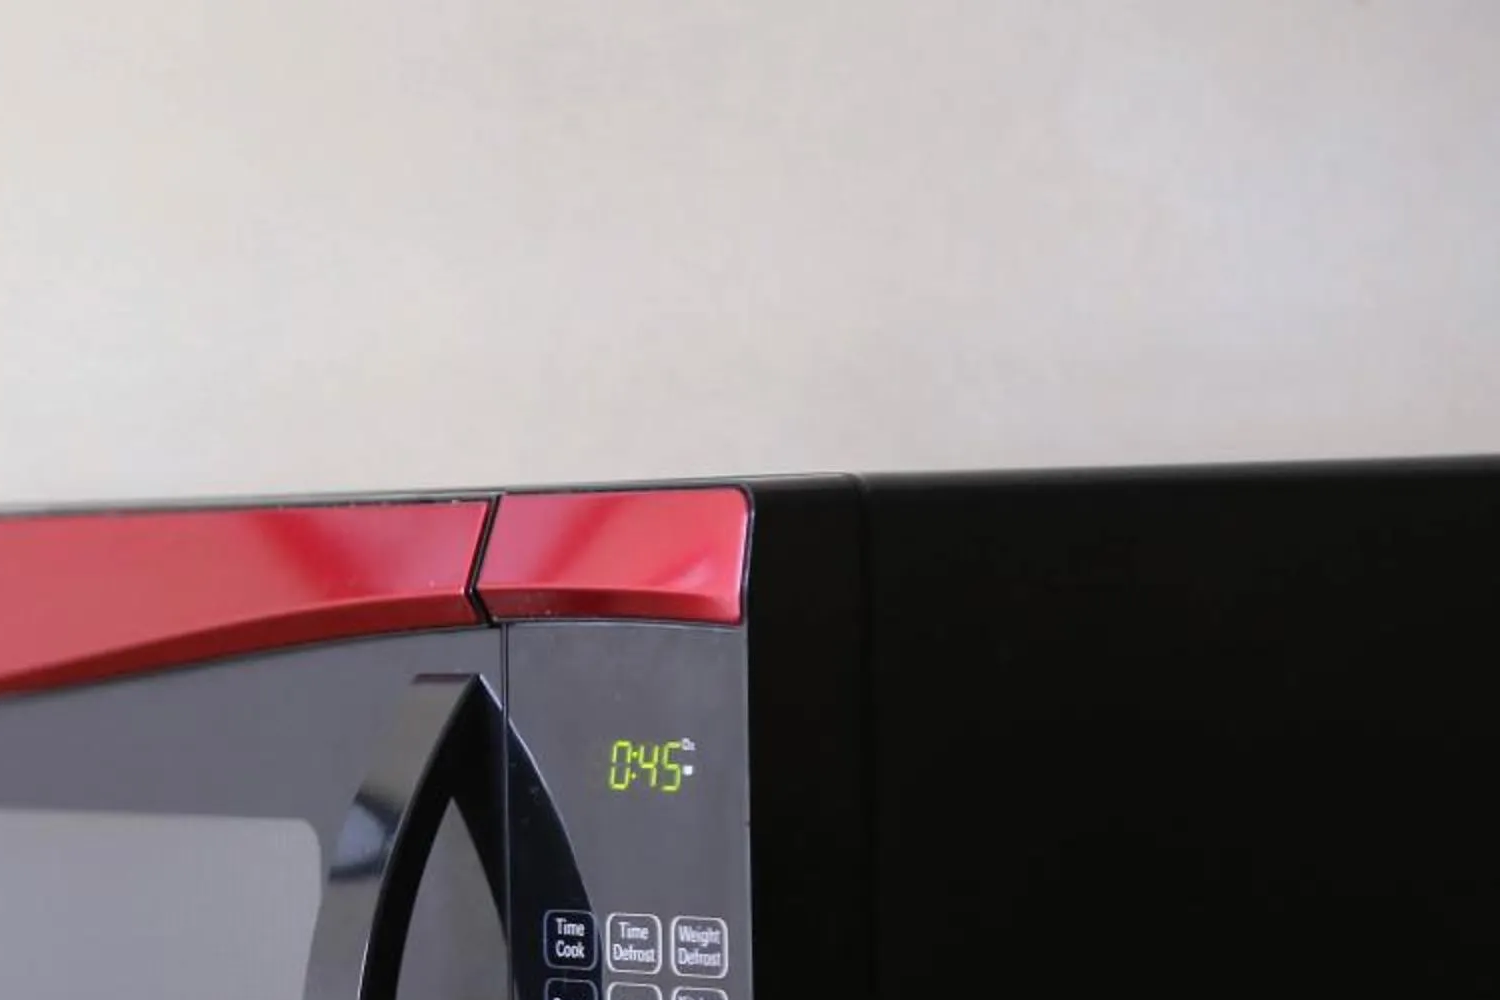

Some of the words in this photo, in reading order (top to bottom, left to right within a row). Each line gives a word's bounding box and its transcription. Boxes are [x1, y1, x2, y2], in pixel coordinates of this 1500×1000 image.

[610, 740, 681, 791] 0:45
[556, 918, 585, 936] Time
[618, 922, 649, 940] Time
[678, 925, 720, 947] Weight
[556, 940, 585, 958] Cook
[613, 944, 655, 962] Defrost
[678, 948, 721, 966] Defrost
